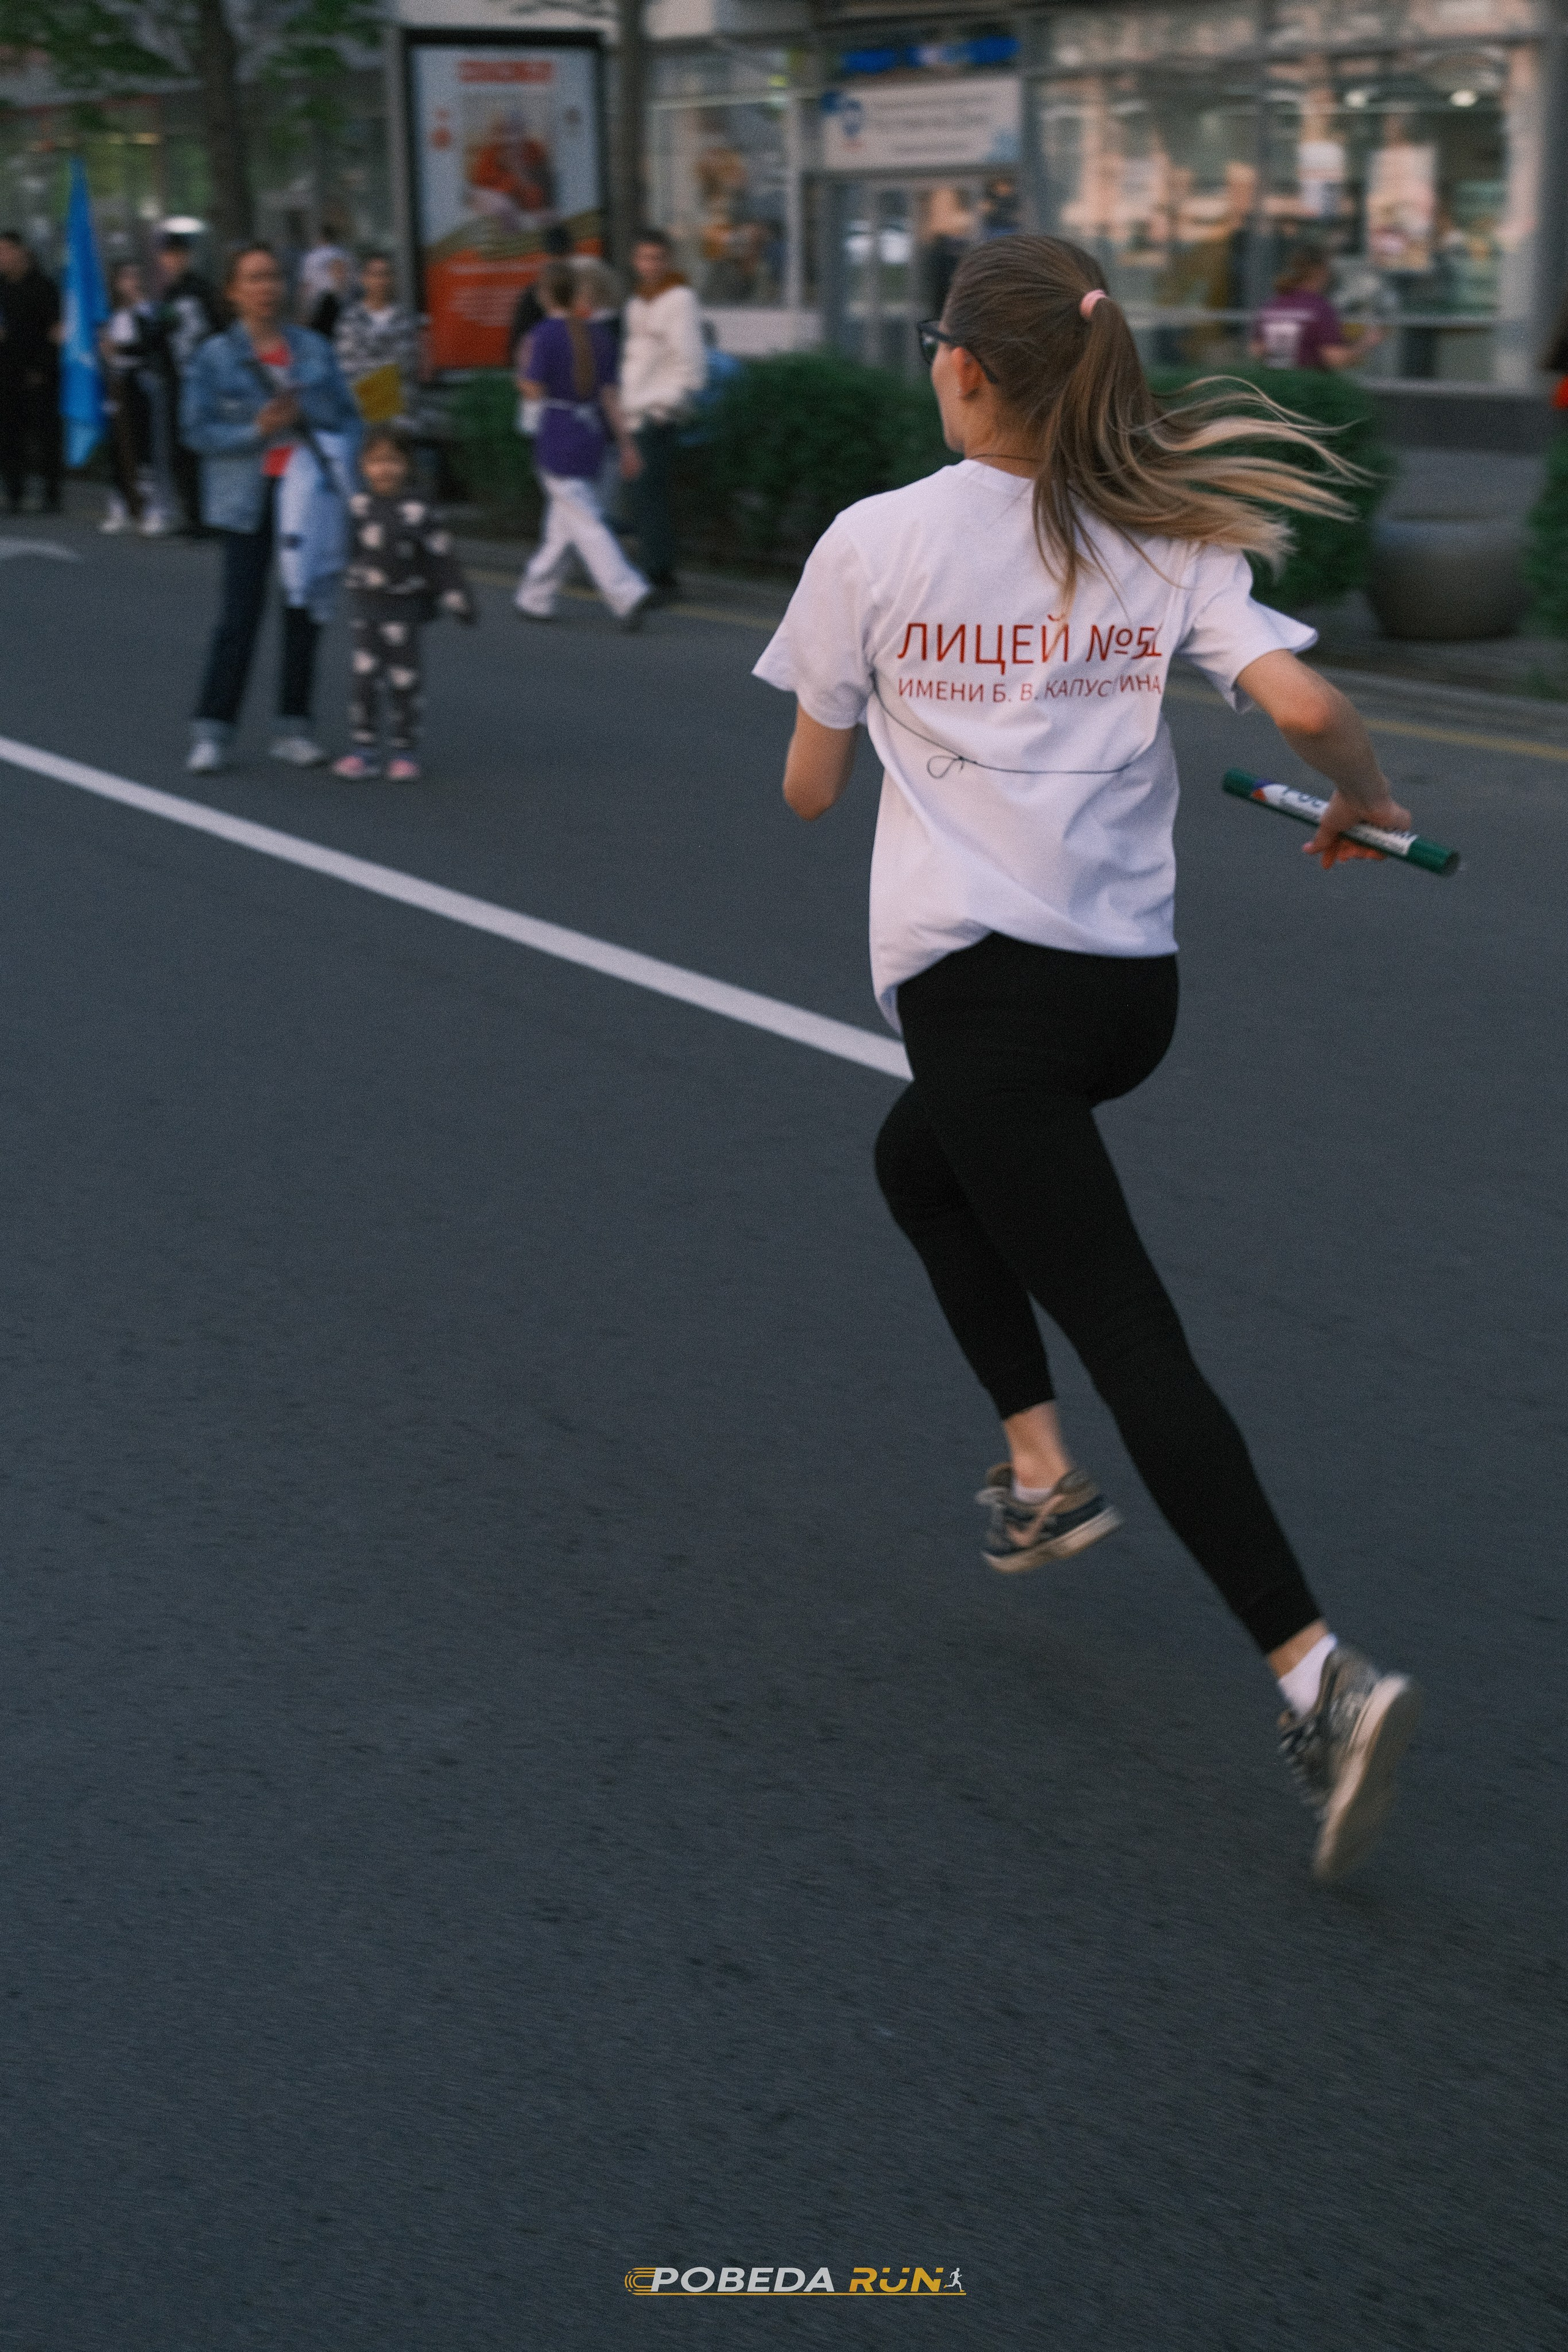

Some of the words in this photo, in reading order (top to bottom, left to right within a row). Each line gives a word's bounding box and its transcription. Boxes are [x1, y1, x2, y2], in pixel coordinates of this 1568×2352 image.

[897, 614, 1069, 675] ЛИЦЕЙ
[898, 678, 984, 703] ИМЕНИ
[992, 682, 1012, 703] Б.
[1020, 682, 1039, 702] В.
[1044, 674, 1162, 699] КАПУСИНА
